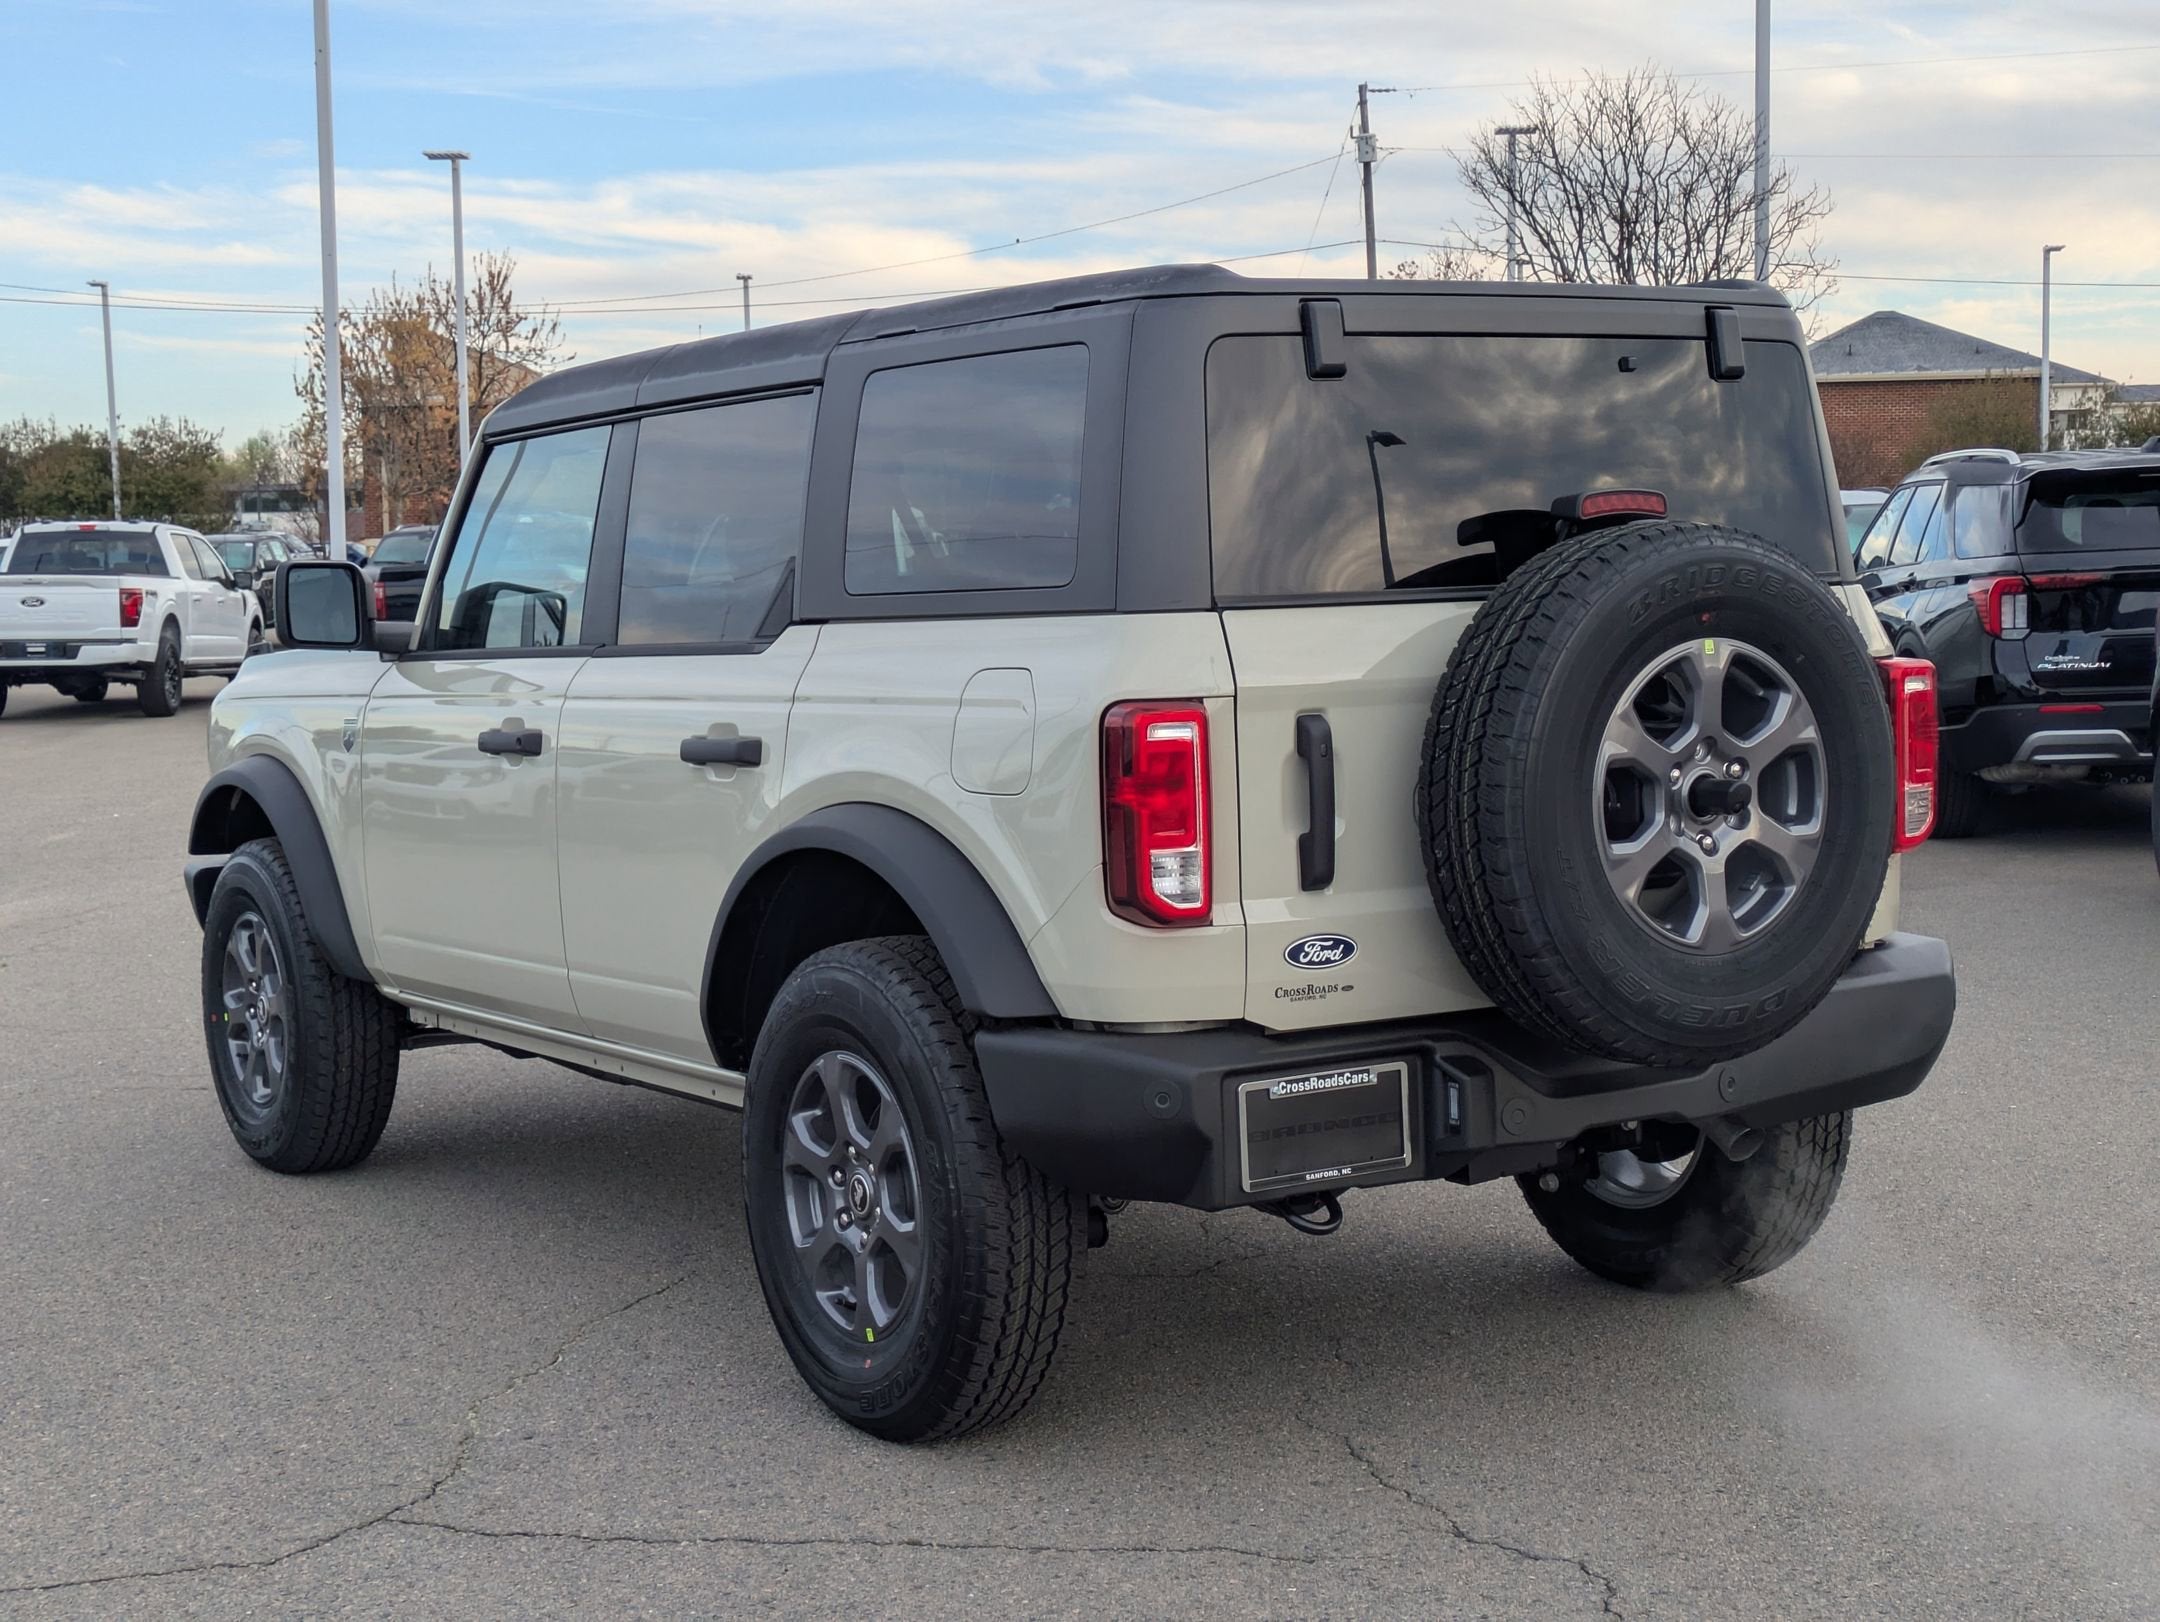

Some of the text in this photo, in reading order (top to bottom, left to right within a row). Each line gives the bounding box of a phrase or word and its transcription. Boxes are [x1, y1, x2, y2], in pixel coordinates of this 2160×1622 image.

[1626, 563, 1873, 705] BRIDGESTONE
[1299, 940, 1344, 963] Ford
[1588, 935, 1791, 1028] DUELER
[1279, 1072, 1369, 1095] CrossRoadsCars
[1249, 1111, 1399, 1143] BRONCO
[1305, 1167, 1352, 1181] SANFORD, NC
